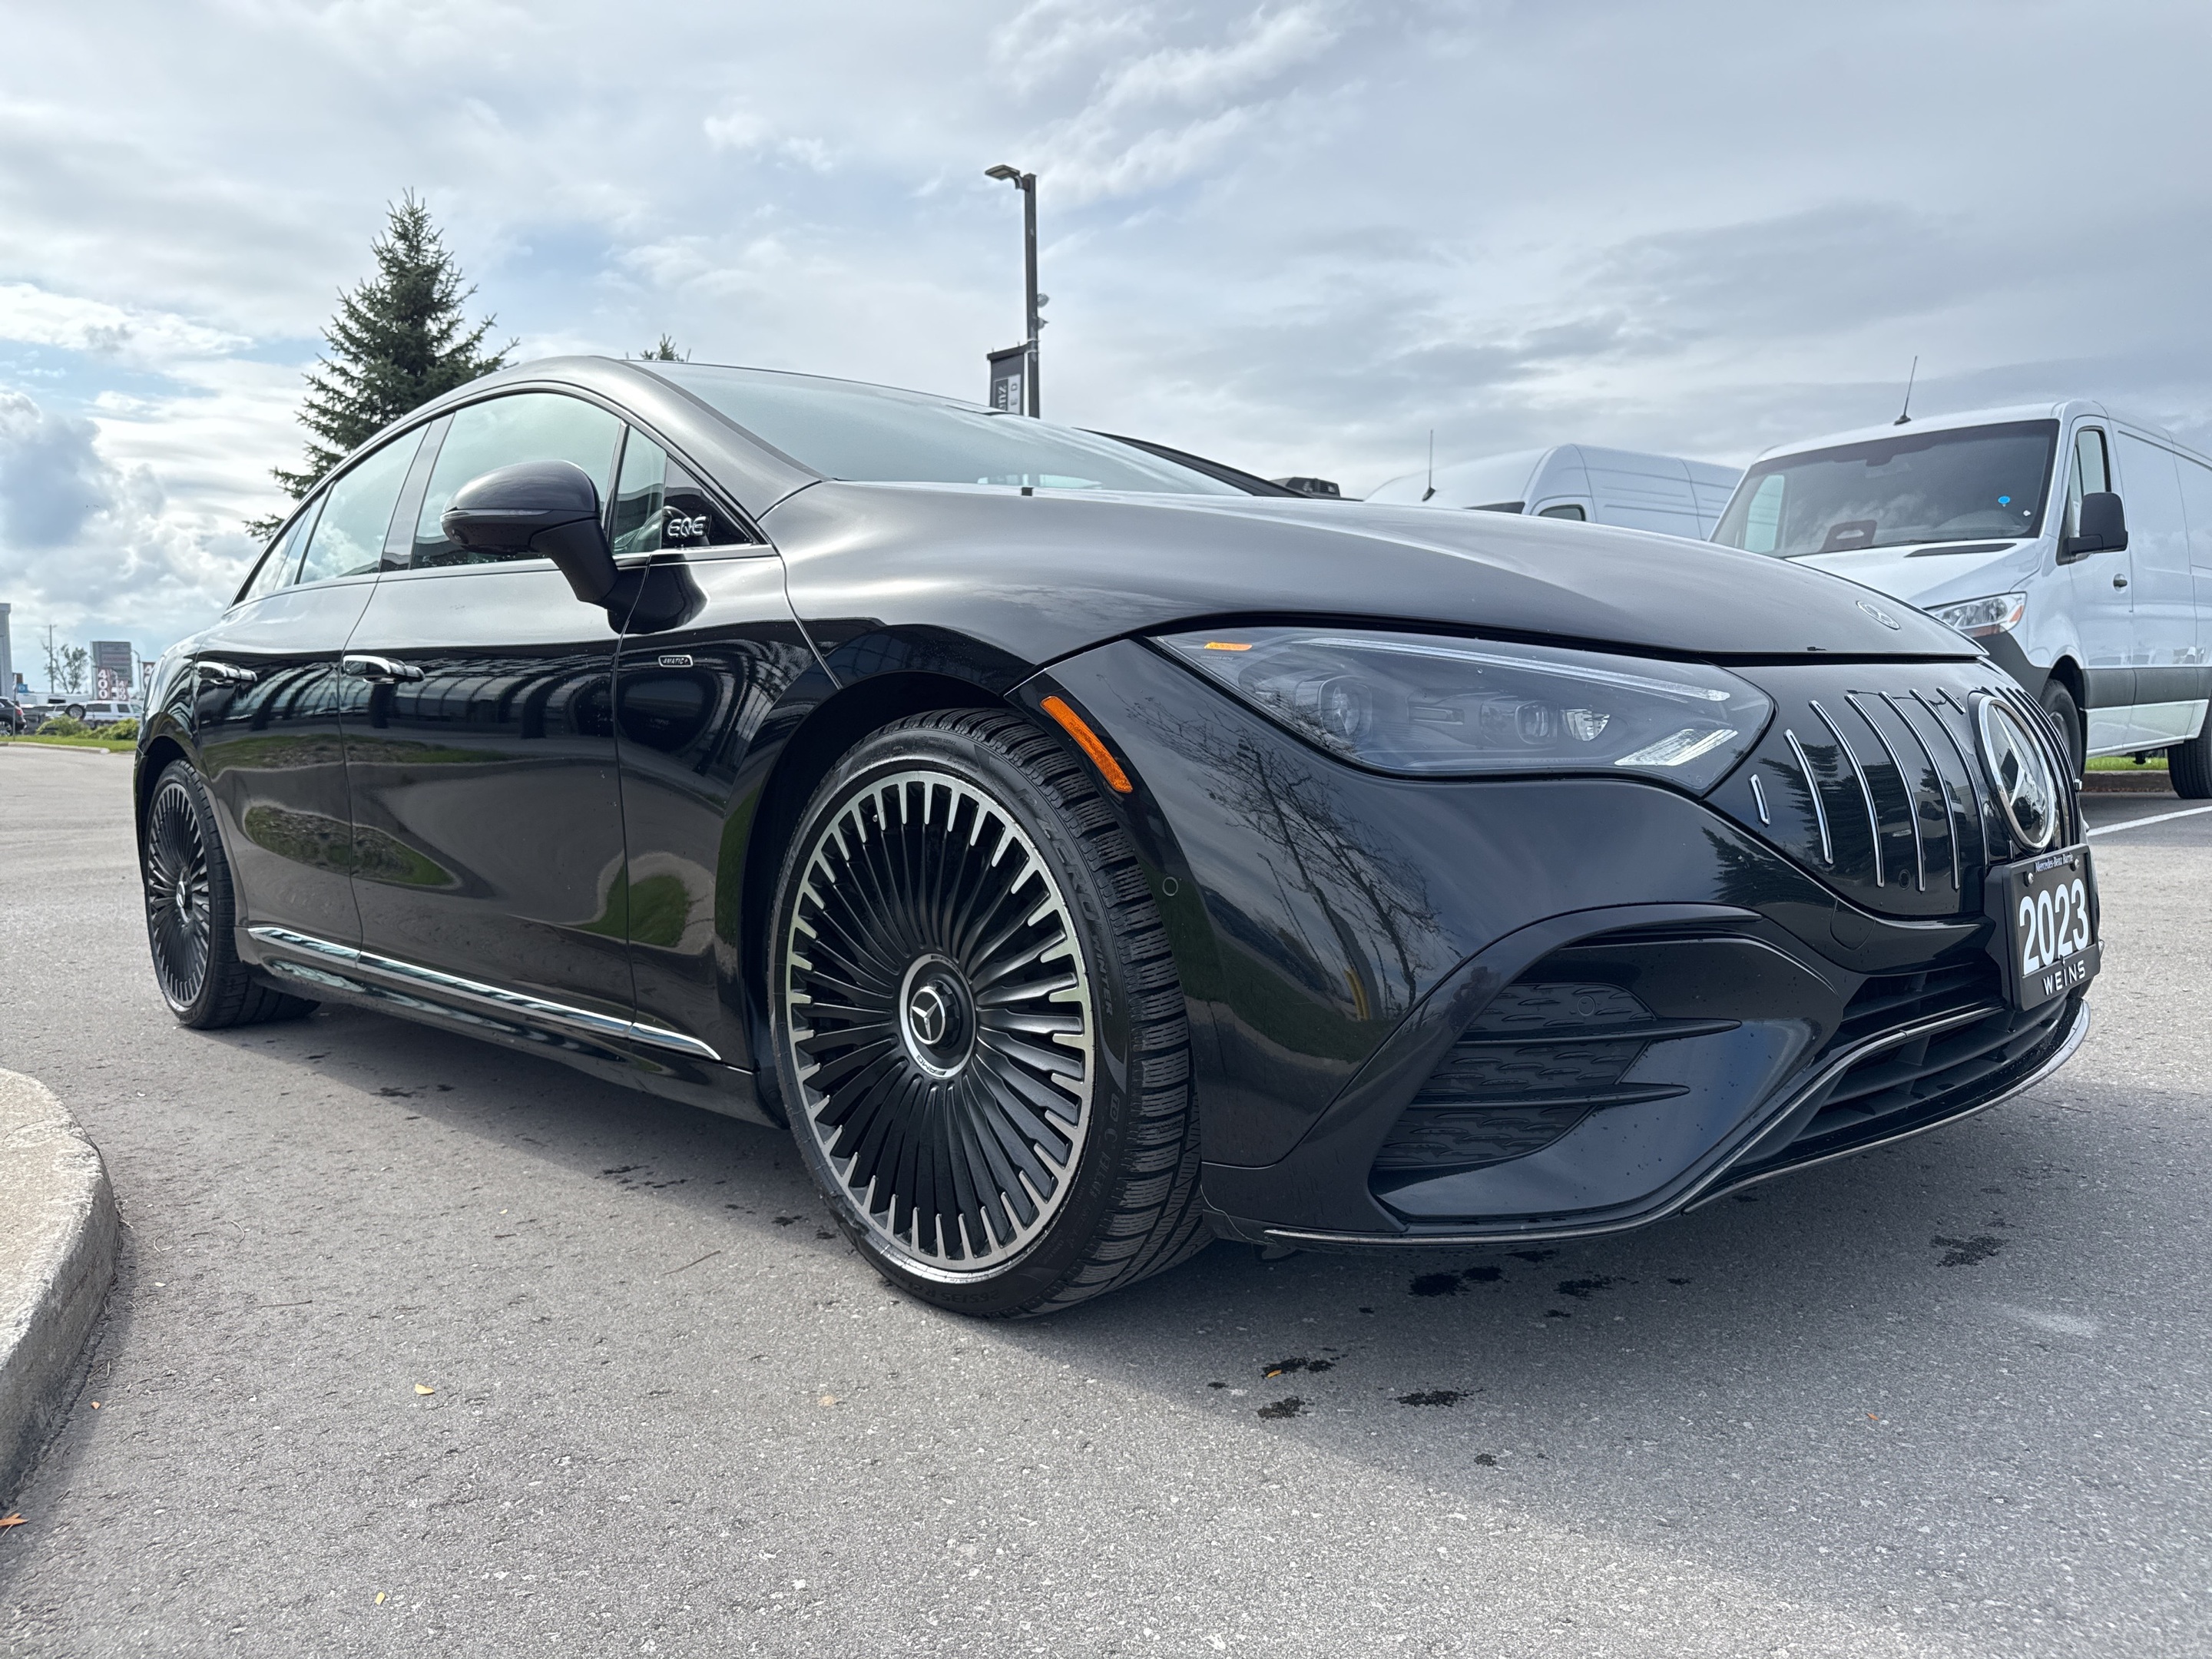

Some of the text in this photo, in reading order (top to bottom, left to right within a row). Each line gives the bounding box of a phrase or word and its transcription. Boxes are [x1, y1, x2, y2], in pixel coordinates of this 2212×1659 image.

[667, 515, 707, 538] EQE
[98, 669, 108, 699] 400
[1037, 813, 1100, 920] ZERO
[1093, 932, 1114, 1016] WINTER
[2019, 878, 2089, 975] 2023
[2043, 959, 2085, 996] WEINS
[916, 1054, 942, 1075] AMG
